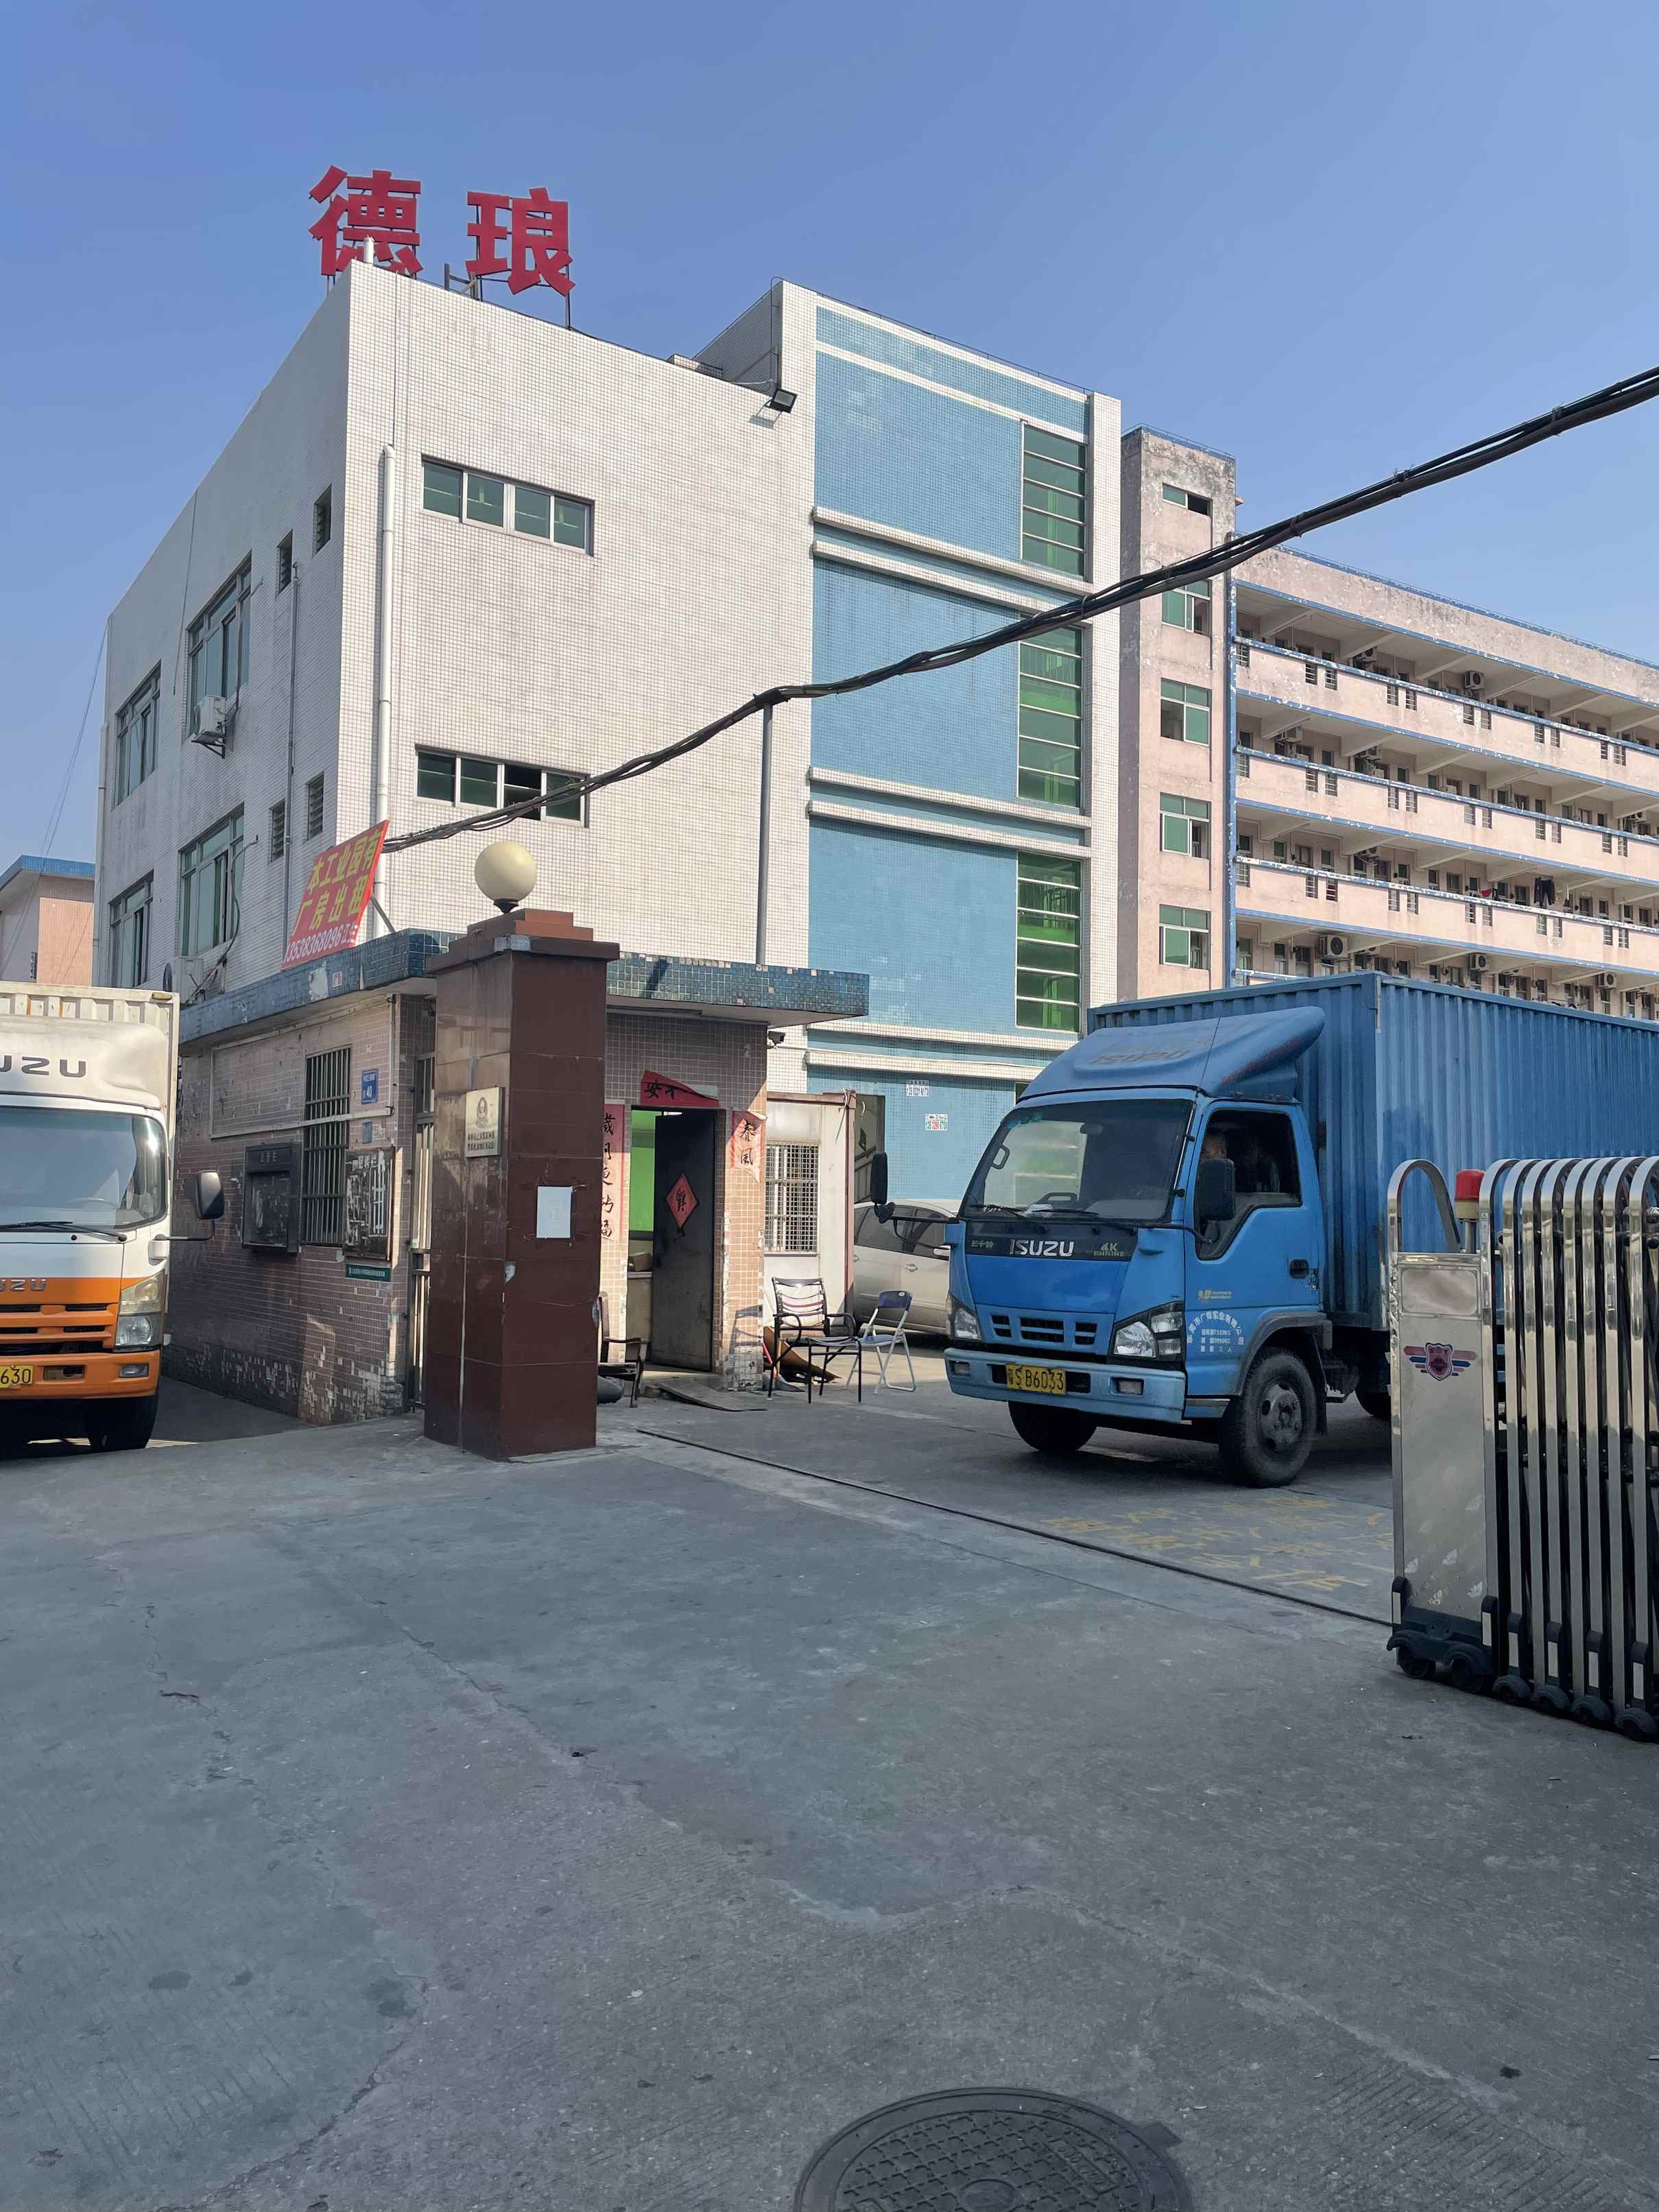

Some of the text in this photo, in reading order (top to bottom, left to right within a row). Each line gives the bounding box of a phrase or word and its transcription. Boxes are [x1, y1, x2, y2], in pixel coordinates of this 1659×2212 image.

[291, 875, 370, 938] 厂房出租
[1009, 1239, 1075, 1257] ISUZU
[1, 1368, 32, 1384] 630
